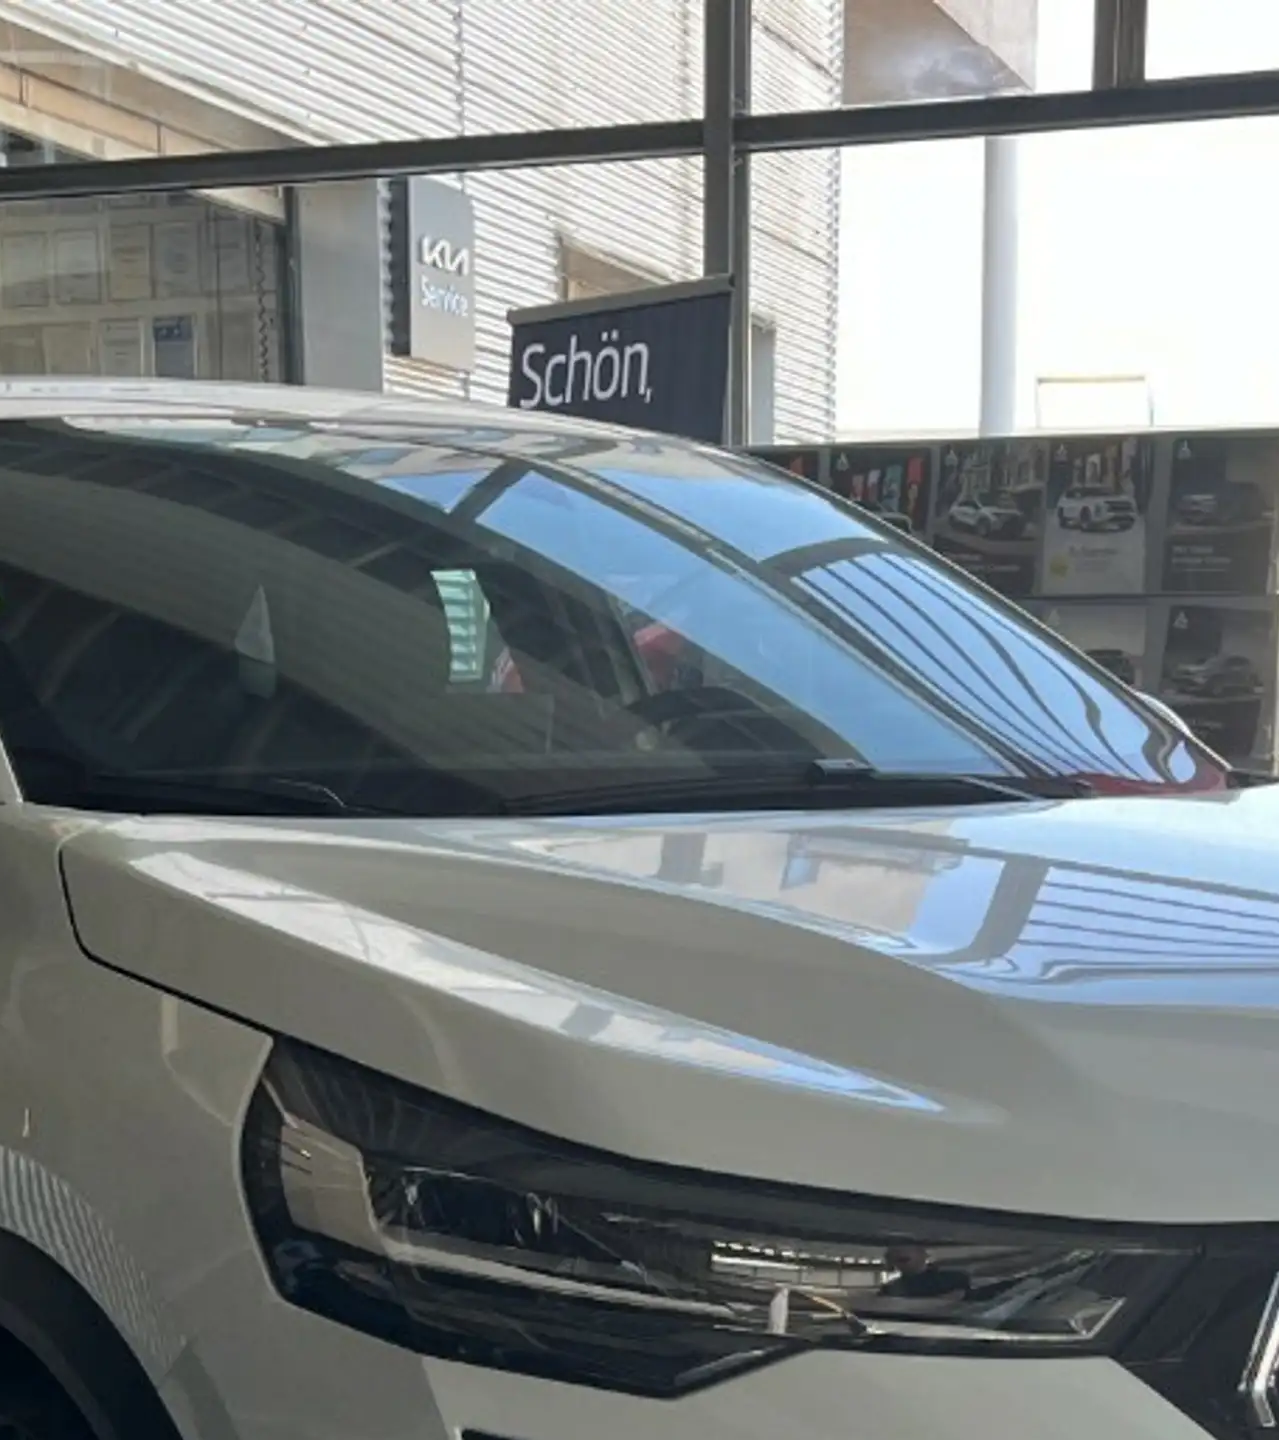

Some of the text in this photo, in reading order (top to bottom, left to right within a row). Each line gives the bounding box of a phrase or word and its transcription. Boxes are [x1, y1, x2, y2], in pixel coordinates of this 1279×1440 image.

[422, 236, 470, 276] KIA
[421, 275, 469, 317] Service
[519, 330, 652, 408] Schön,
